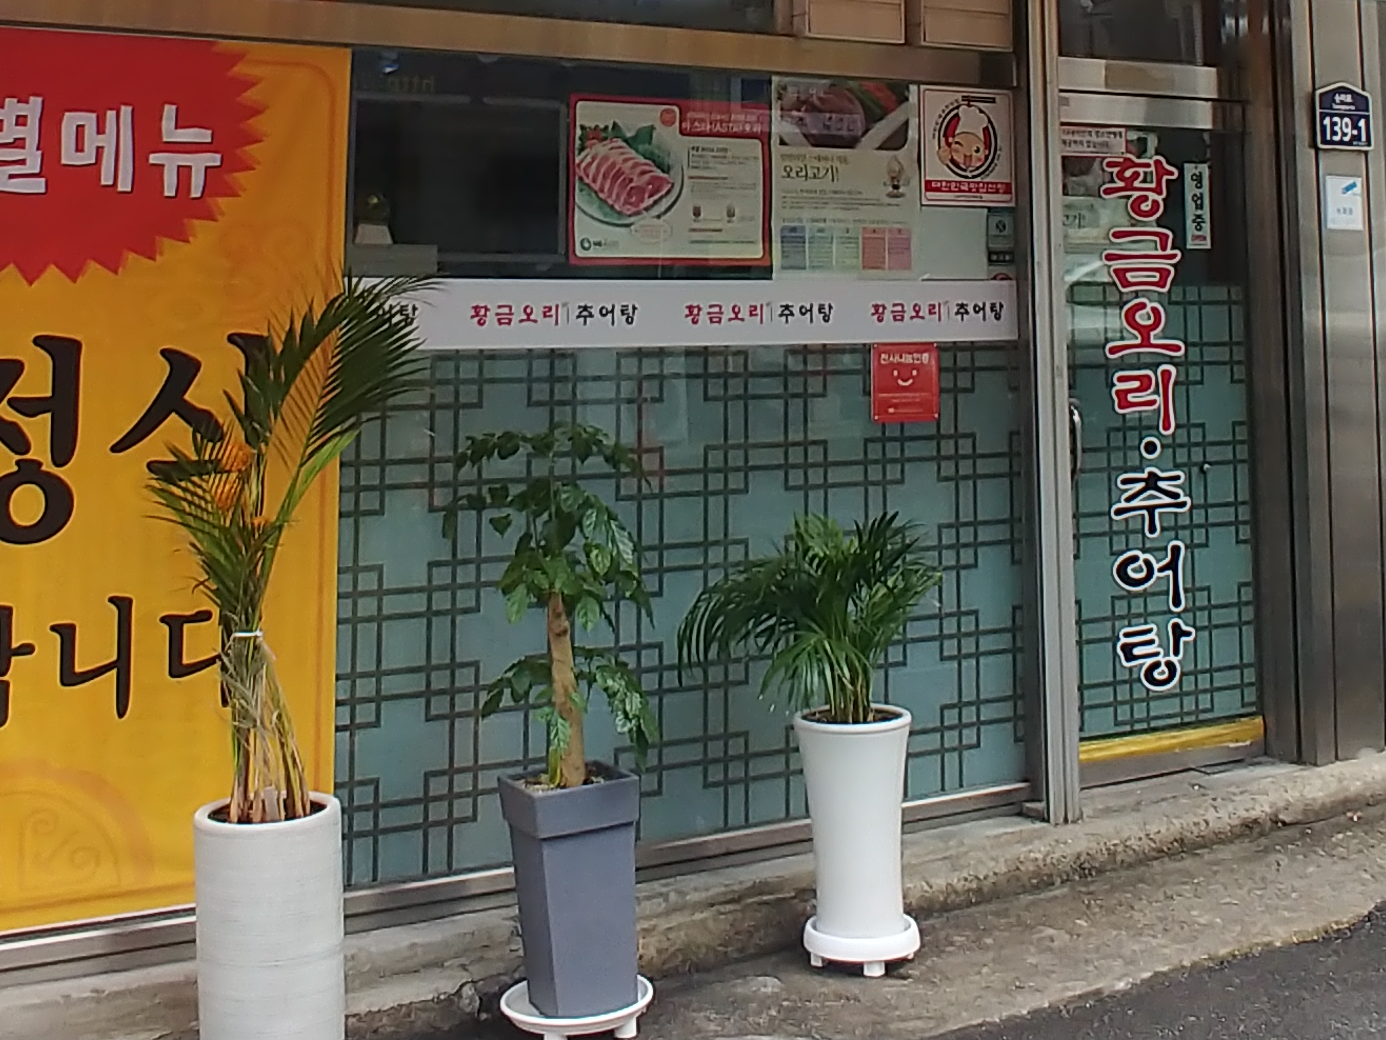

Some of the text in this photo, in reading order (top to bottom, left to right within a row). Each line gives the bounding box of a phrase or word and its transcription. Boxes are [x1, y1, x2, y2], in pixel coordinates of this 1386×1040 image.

[1322, 115, 1367, 143] 139-1
[1190, 171, 1207, 232] 영업중
[469, 303, 639, 327] 황금오리 추어탕
[684, 302, 834, 325] 황금오리 추어탕
[870, 301, 1005, 323] 황금오리 추어탕
[1101, 153, 1196, 693] 황금오리 추어탕
